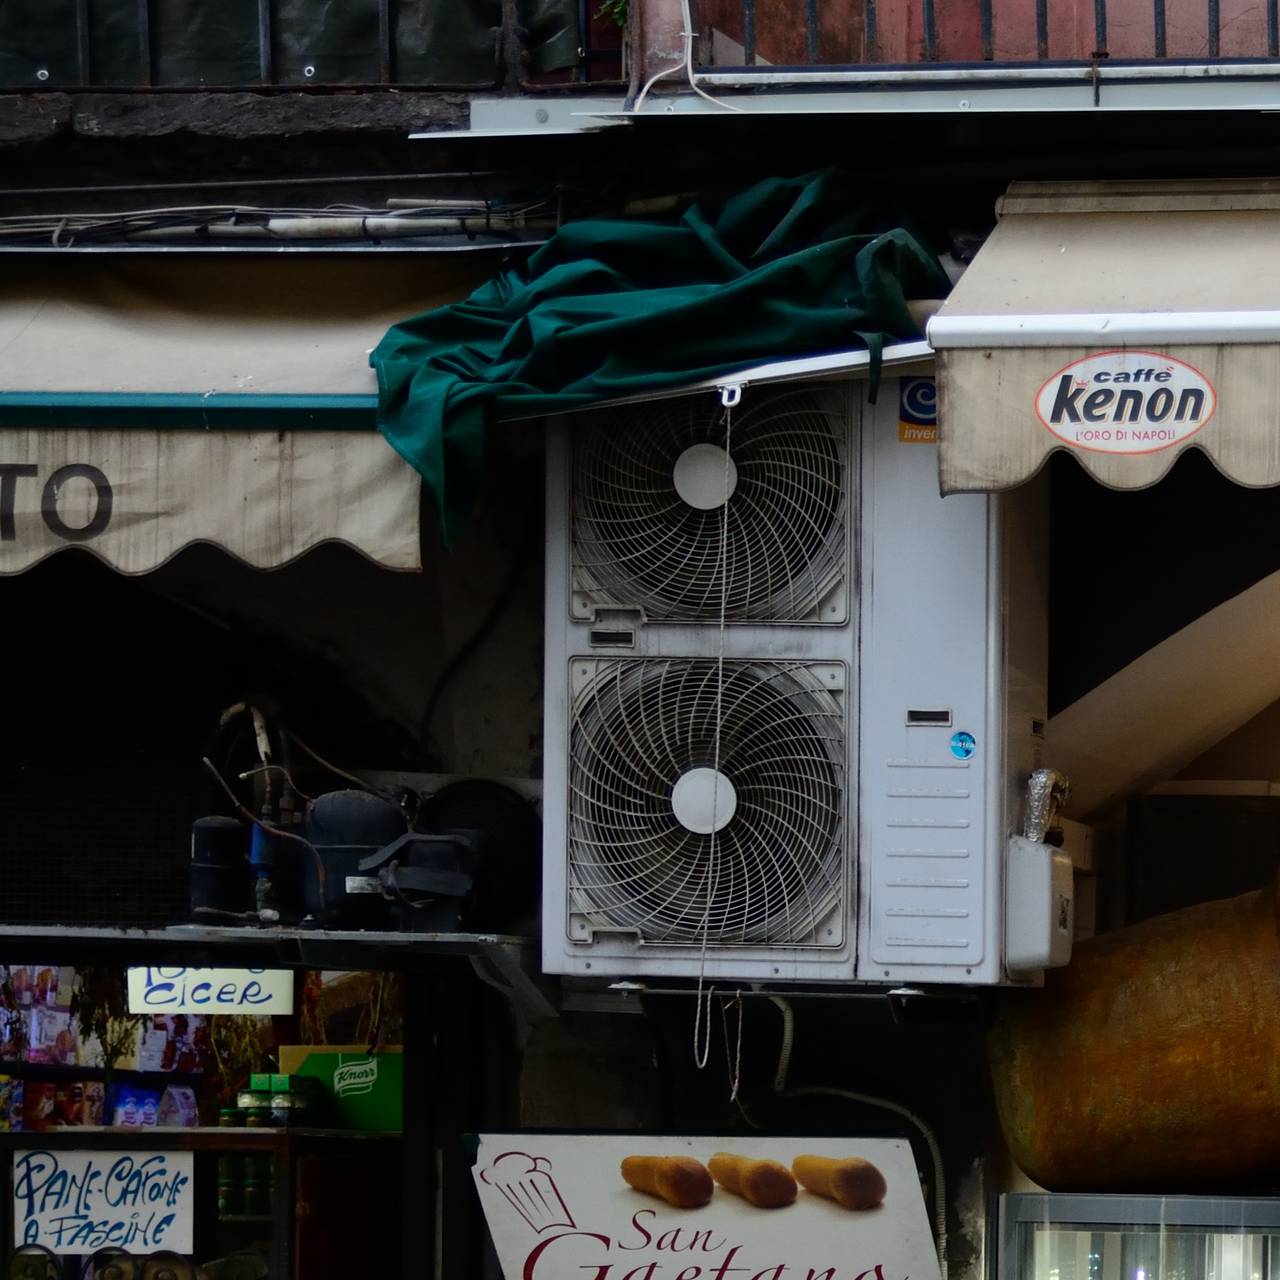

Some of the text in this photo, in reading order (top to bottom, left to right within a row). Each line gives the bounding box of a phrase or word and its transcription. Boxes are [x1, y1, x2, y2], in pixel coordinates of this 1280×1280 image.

[1050, 375, 1205, 424] kenon
[904, 425, 938, 439] inver
[1076, 430, 1176, 442] L'ORO DI NAPOLI
[0, 464, 113, 542] TO
[336, 1068, 375, 1084] Knorr
[618, 1209, 726, 1252] San
